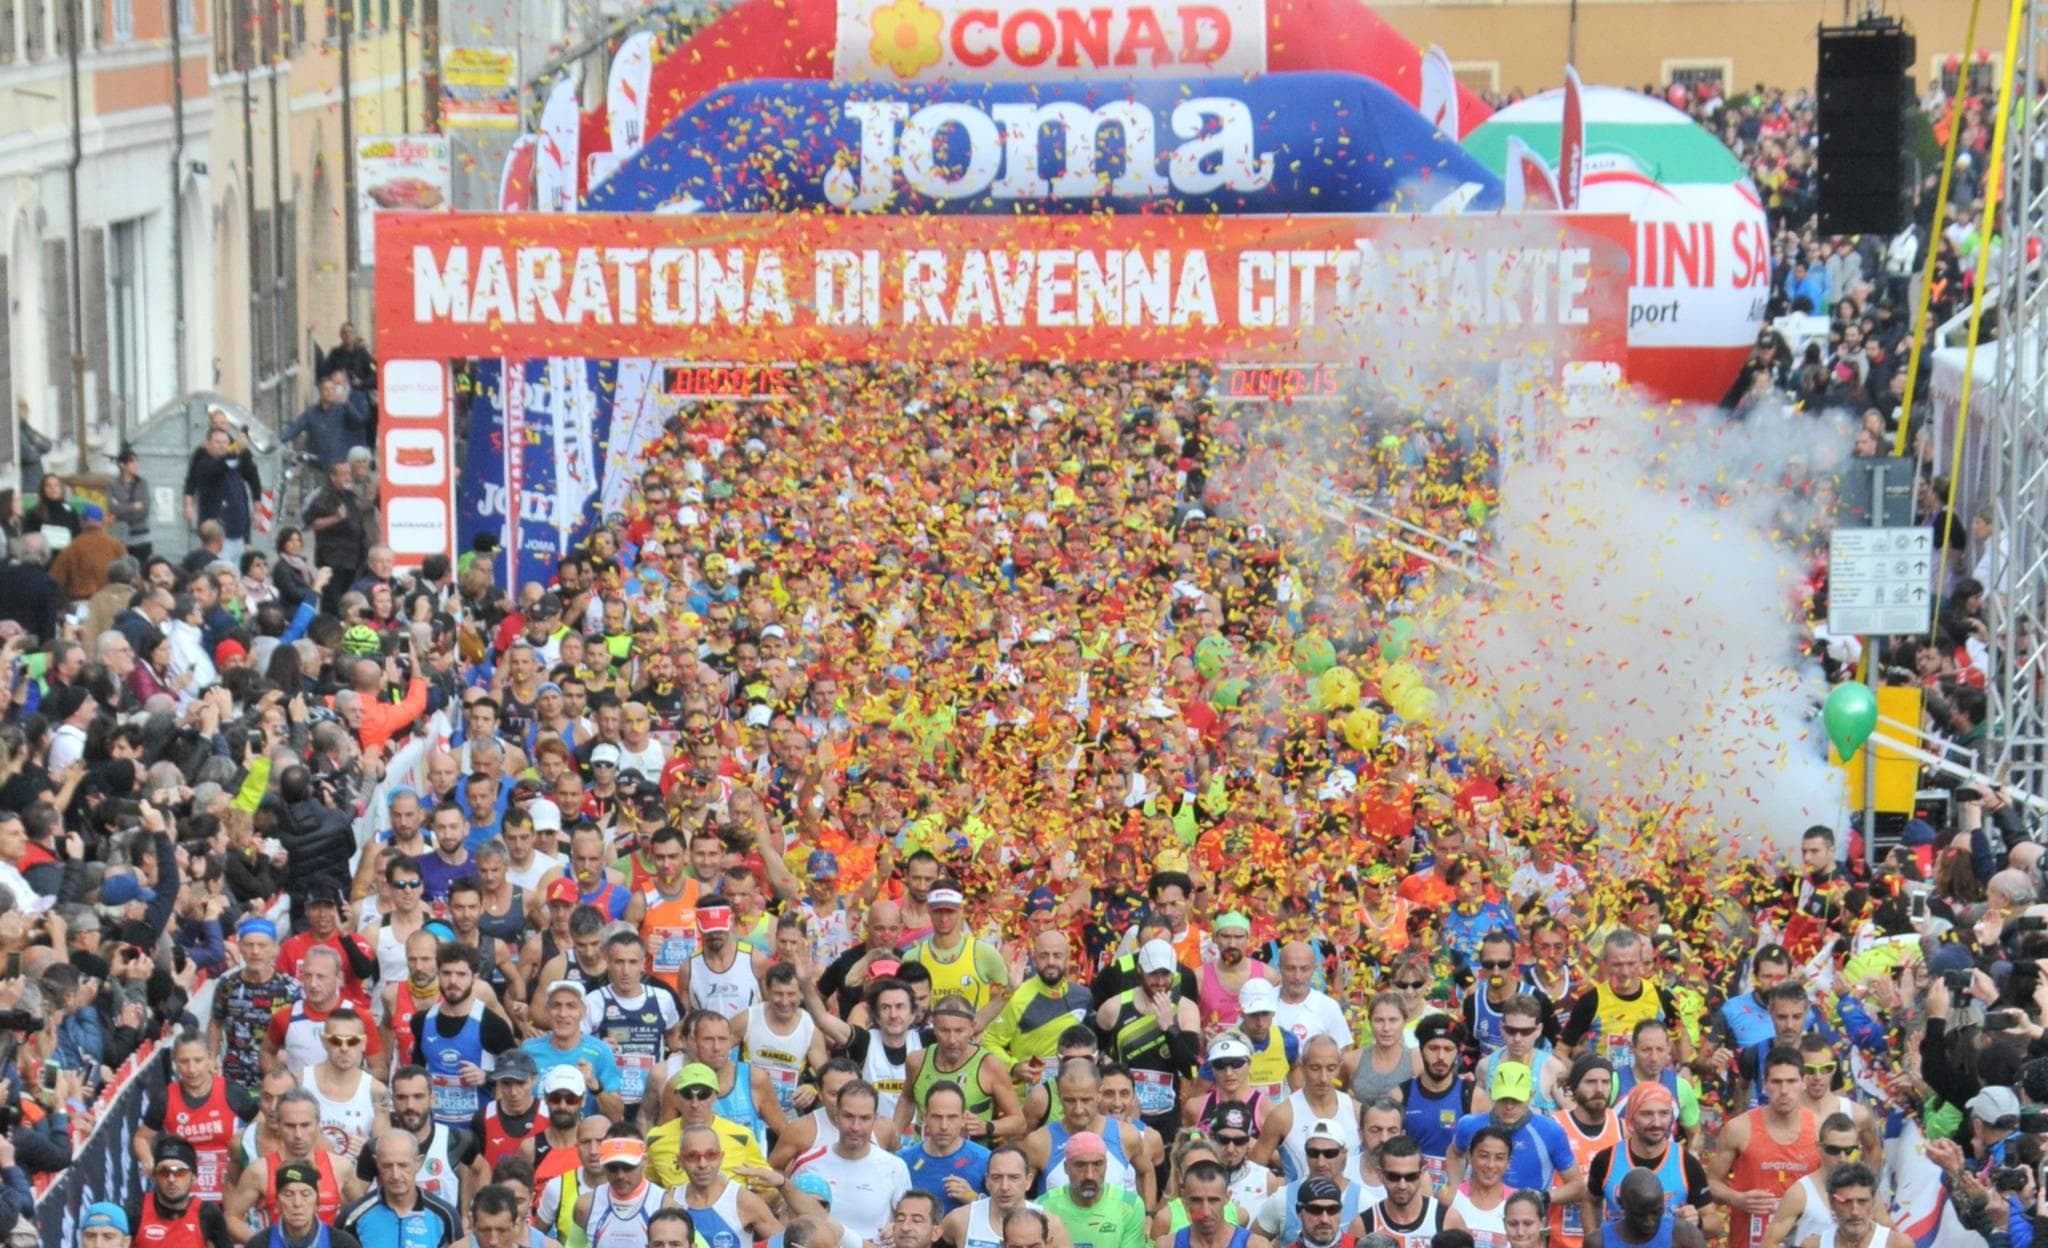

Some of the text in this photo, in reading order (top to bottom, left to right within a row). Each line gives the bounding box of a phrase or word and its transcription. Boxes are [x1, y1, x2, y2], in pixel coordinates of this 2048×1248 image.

[950, 6, 1232, 69] CONAD
[823, 97, 1275, 208] Joma
[413, 245, 795, 326] MARATONA
[815, 249, 881, 326] DI
[902, 248, 1220, 327] RAVENNA
[176, 1120, 224, 1137] GOLDEN
